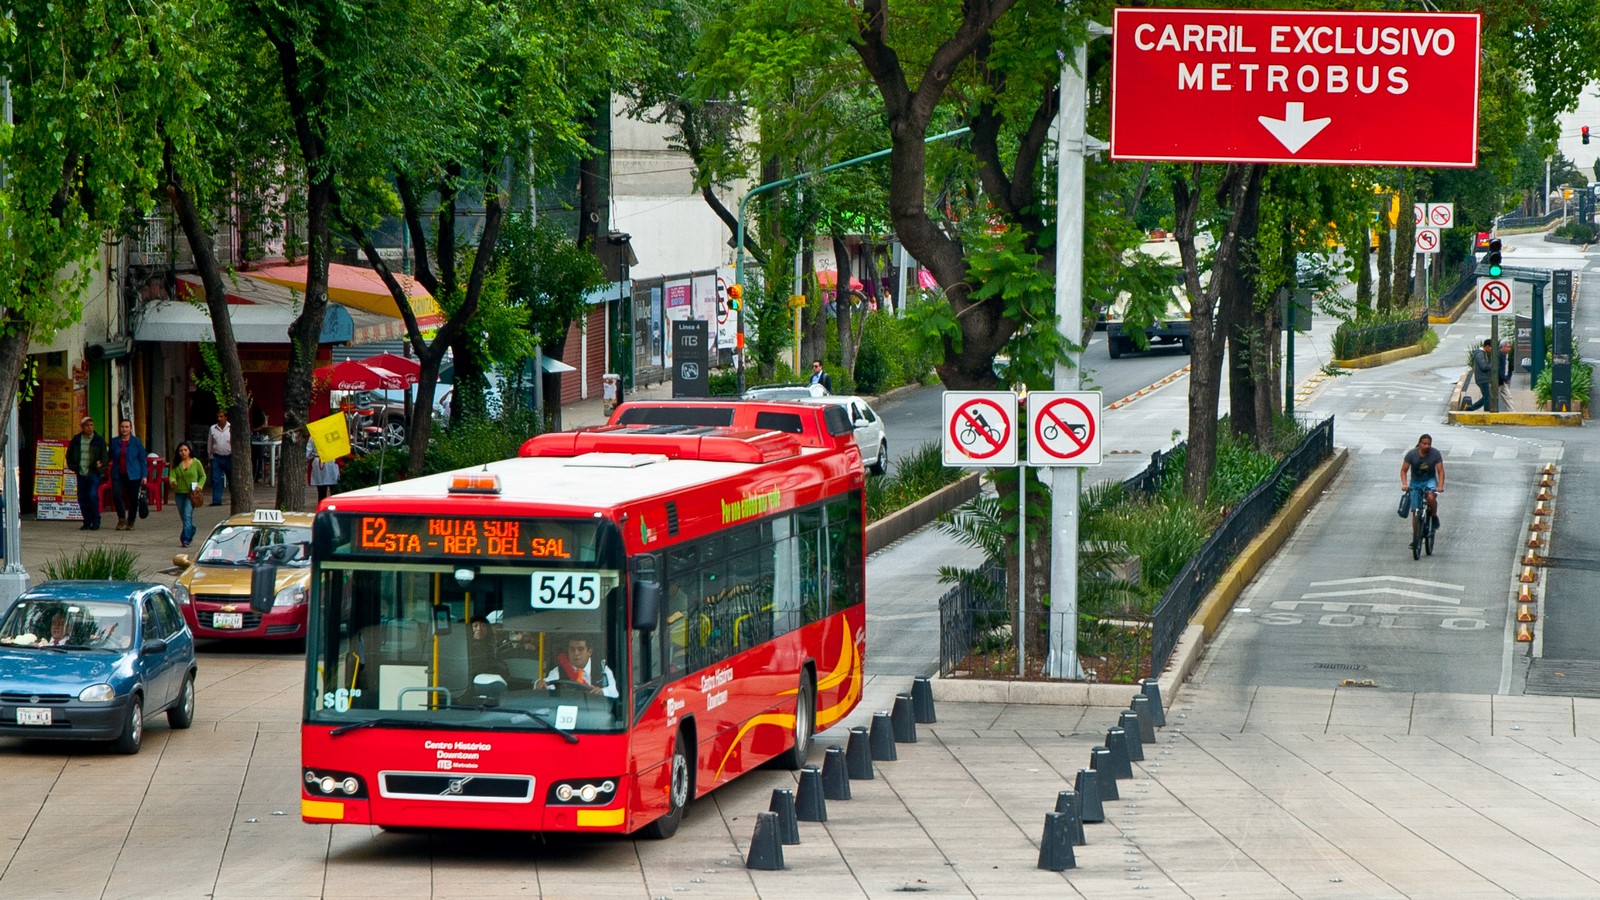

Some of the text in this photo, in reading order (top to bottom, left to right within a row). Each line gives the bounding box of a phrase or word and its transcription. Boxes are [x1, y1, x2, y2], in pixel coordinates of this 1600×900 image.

[1134, 23, 1455, 57] CARRIL EXCLUSIVO
[1177, 62, 1409, 95] METROBUS
[257, 511, 279, 521] TAXI
[362, 517, 388, 548] E2
[487, 536, 525, 556] DEL
[539, 576, 595, 605] 545
[1256, 611, 1491, 631] SOLO
[424, 740, 453, 750] Centro
[436, 750, 480, 760] Downtown
